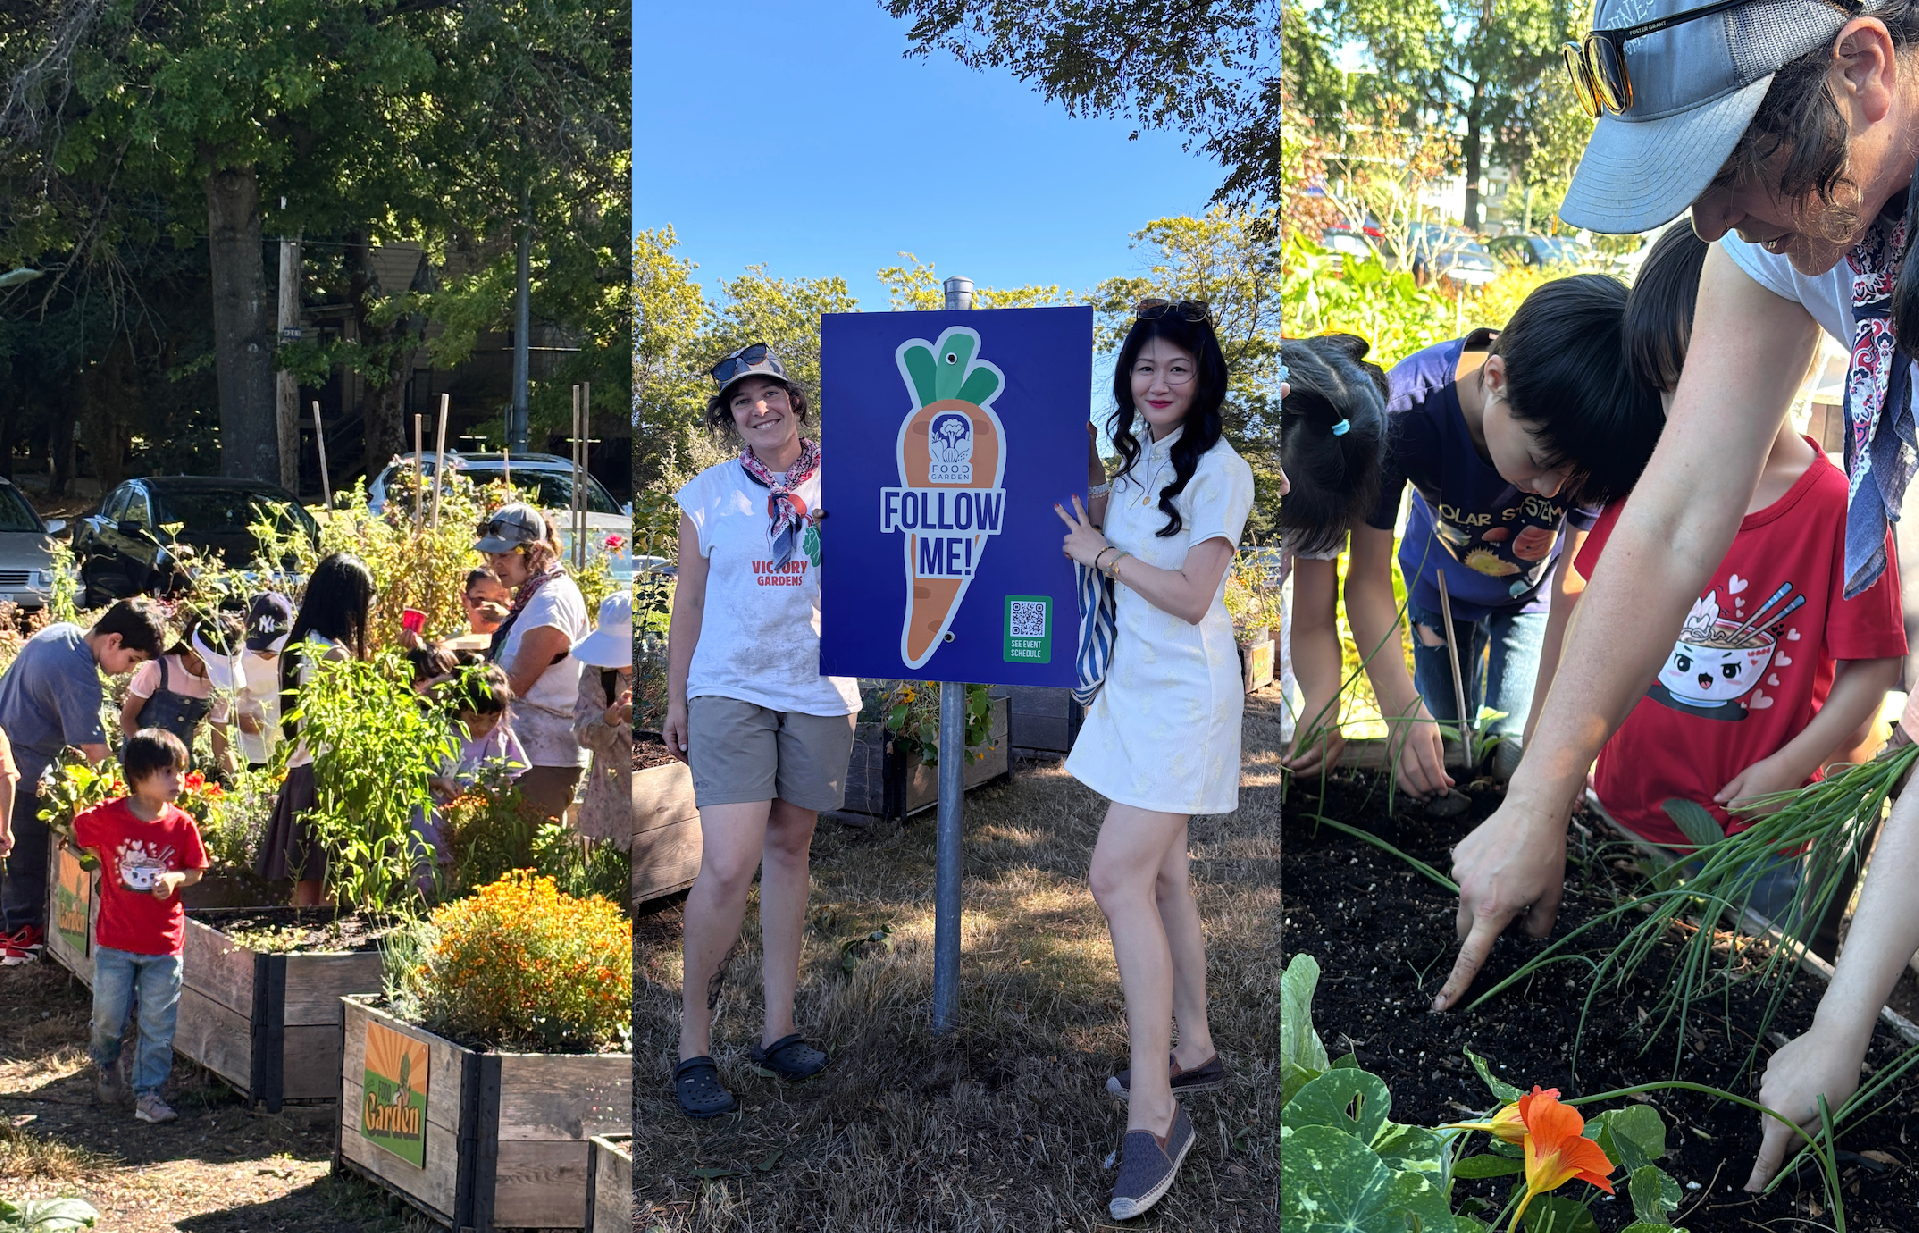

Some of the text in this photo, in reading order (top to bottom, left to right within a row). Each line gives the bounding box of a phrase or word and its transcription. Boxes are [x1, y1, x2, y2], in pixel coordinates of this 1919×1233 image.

[932, 465, 970, 473] FOOD
[885, 492, 1002, 530] FOLLOW
[1440, 504, 1491, 527] OLAR
[920, 537, 972, 575] ME!
[752, 561, 808, 574] VICORY
[757, 576, 803, 586] GARDENS
[1011, 640, 1041, 649] SEE EVENT
[1011, 649, 1041, 658] SCHEDULE
[365, 1091, 419, 1136] Garden
